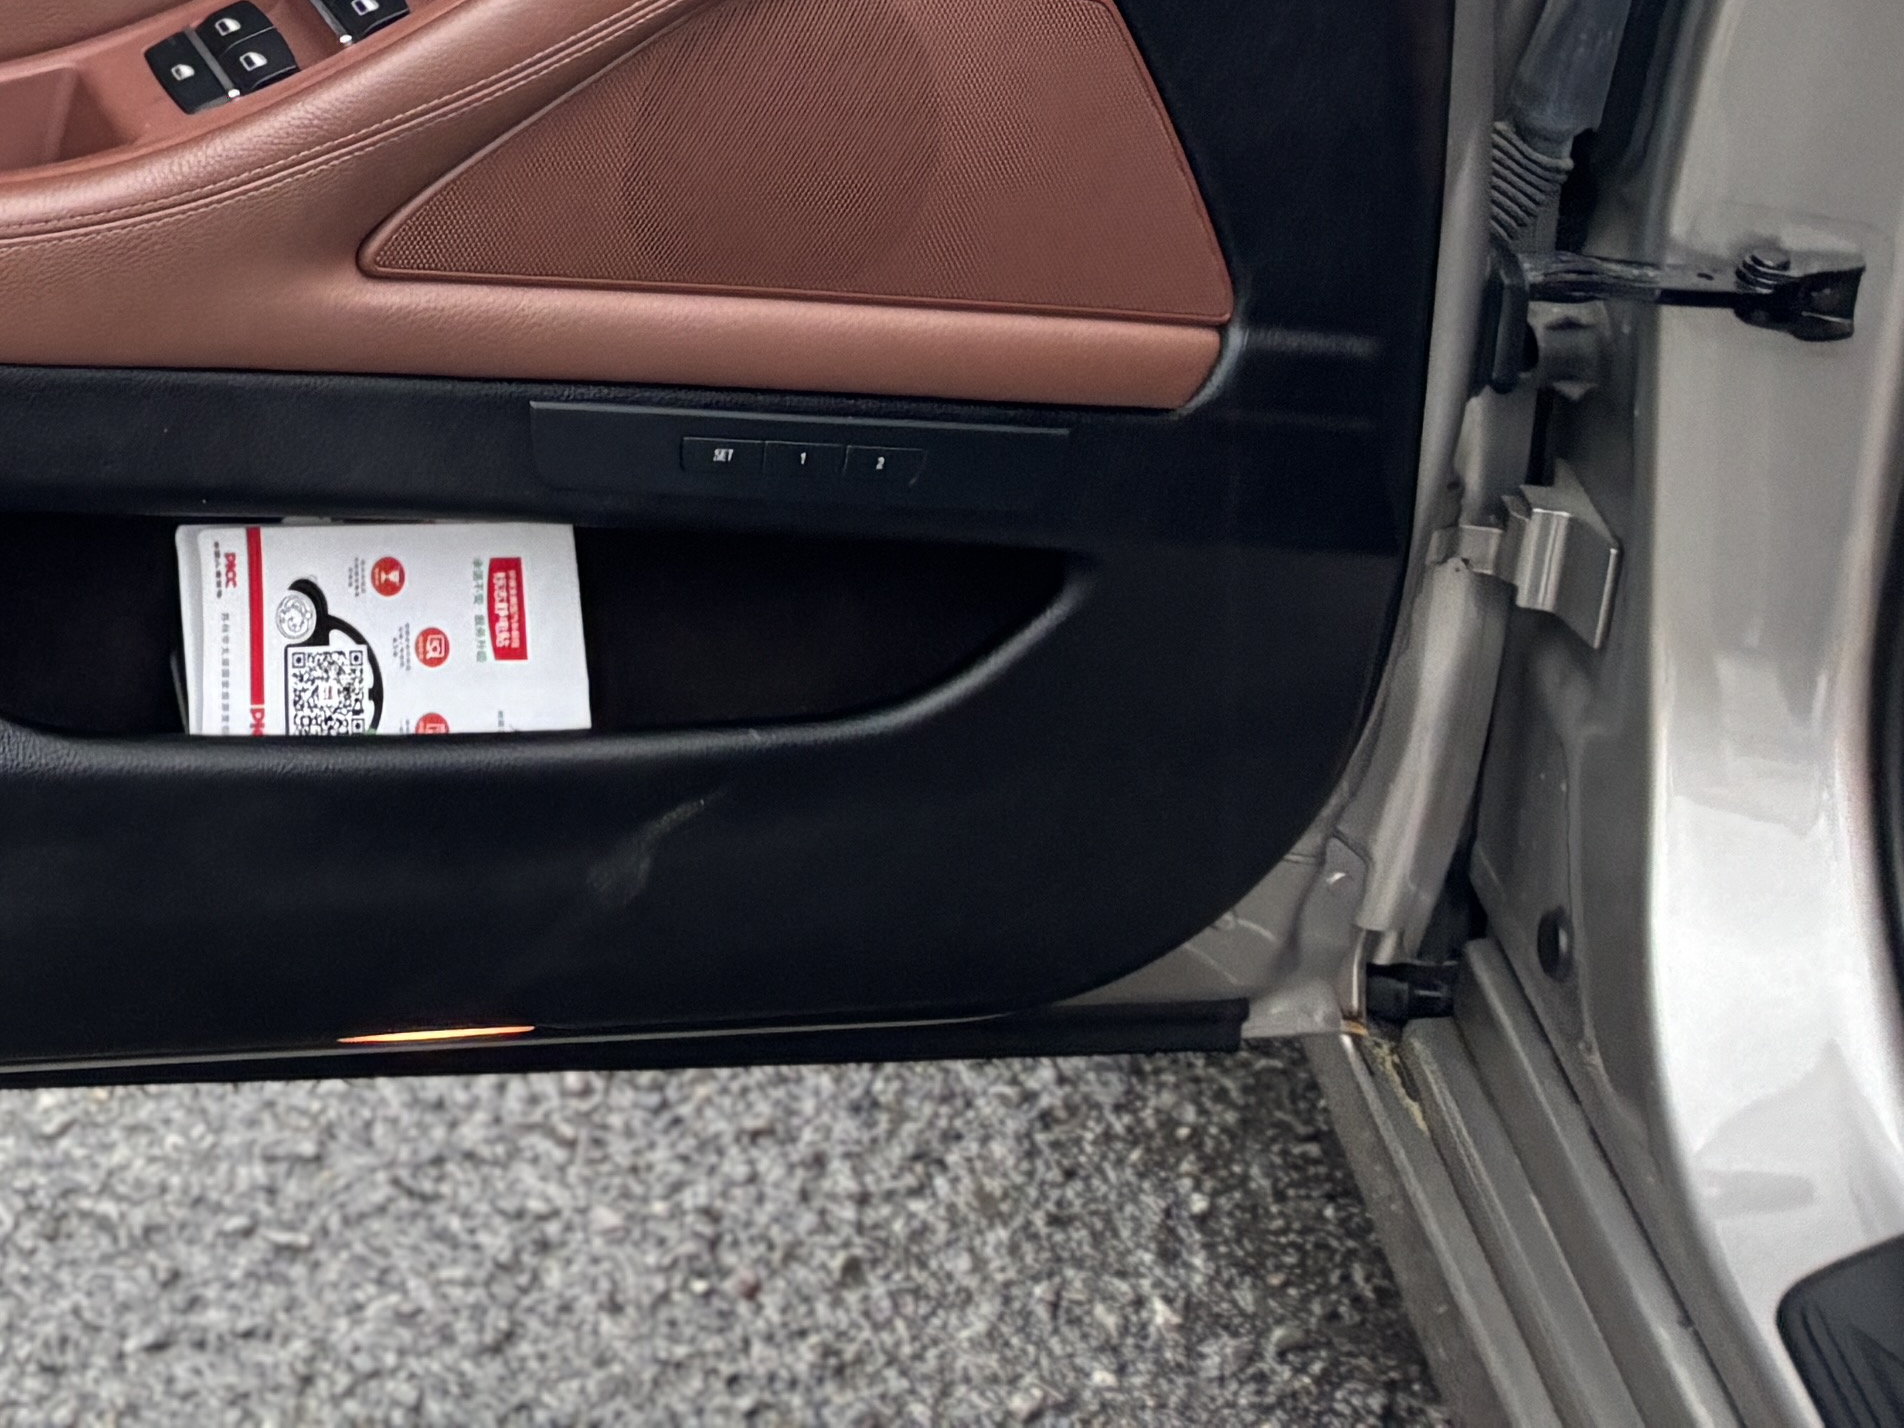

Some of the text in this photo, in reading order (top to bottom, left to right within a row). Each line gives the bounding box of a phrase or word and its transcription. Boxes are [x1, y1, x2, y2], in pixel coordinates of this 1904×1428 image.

[713, 448, 885, 470] SET 1 2
[224, 552, 237, 589] PICC
